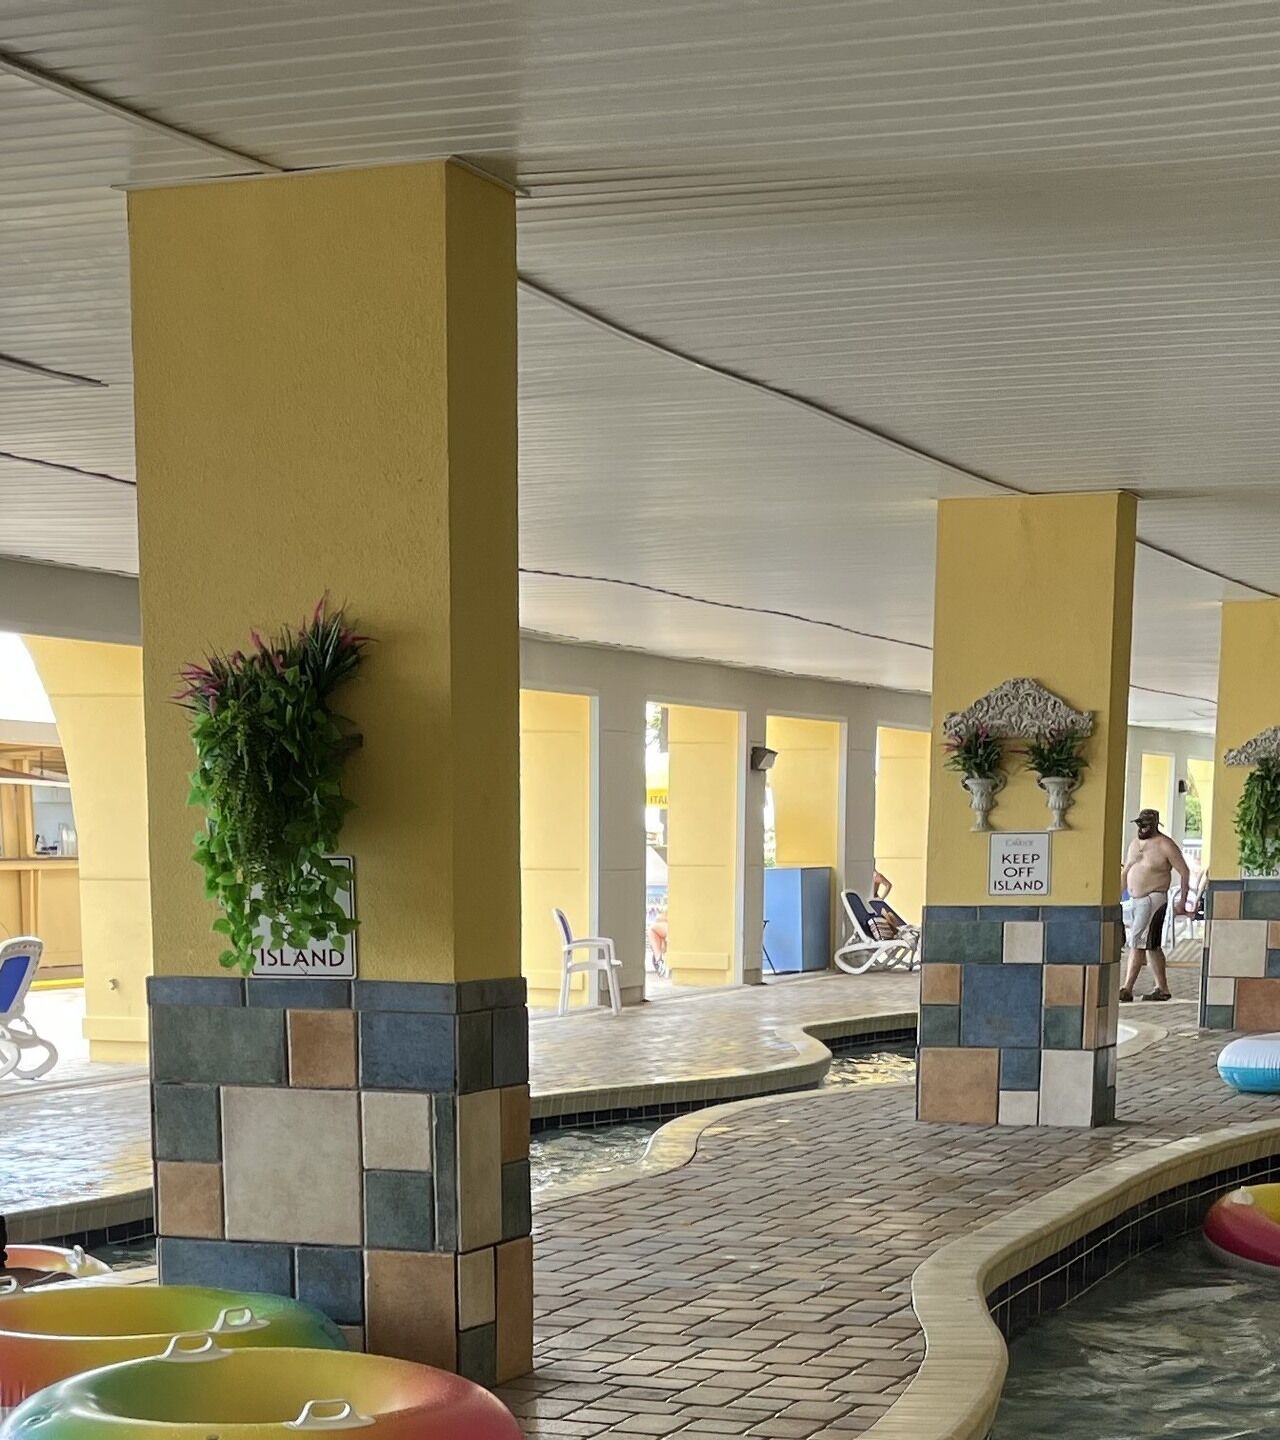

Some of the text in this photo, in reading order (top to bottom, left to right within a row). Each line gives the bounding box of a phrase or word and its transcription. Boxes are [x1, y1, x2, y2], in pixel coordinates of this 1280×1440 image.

[1001, 853, 1041, 865] KEEP
[1003, 866, 1035, 878] OFF
[1244, 868, 1280, 878] ISLAD
[993, 880, 1044, 891] ISLAND
[260, 947, 346, 967] ISLAND
